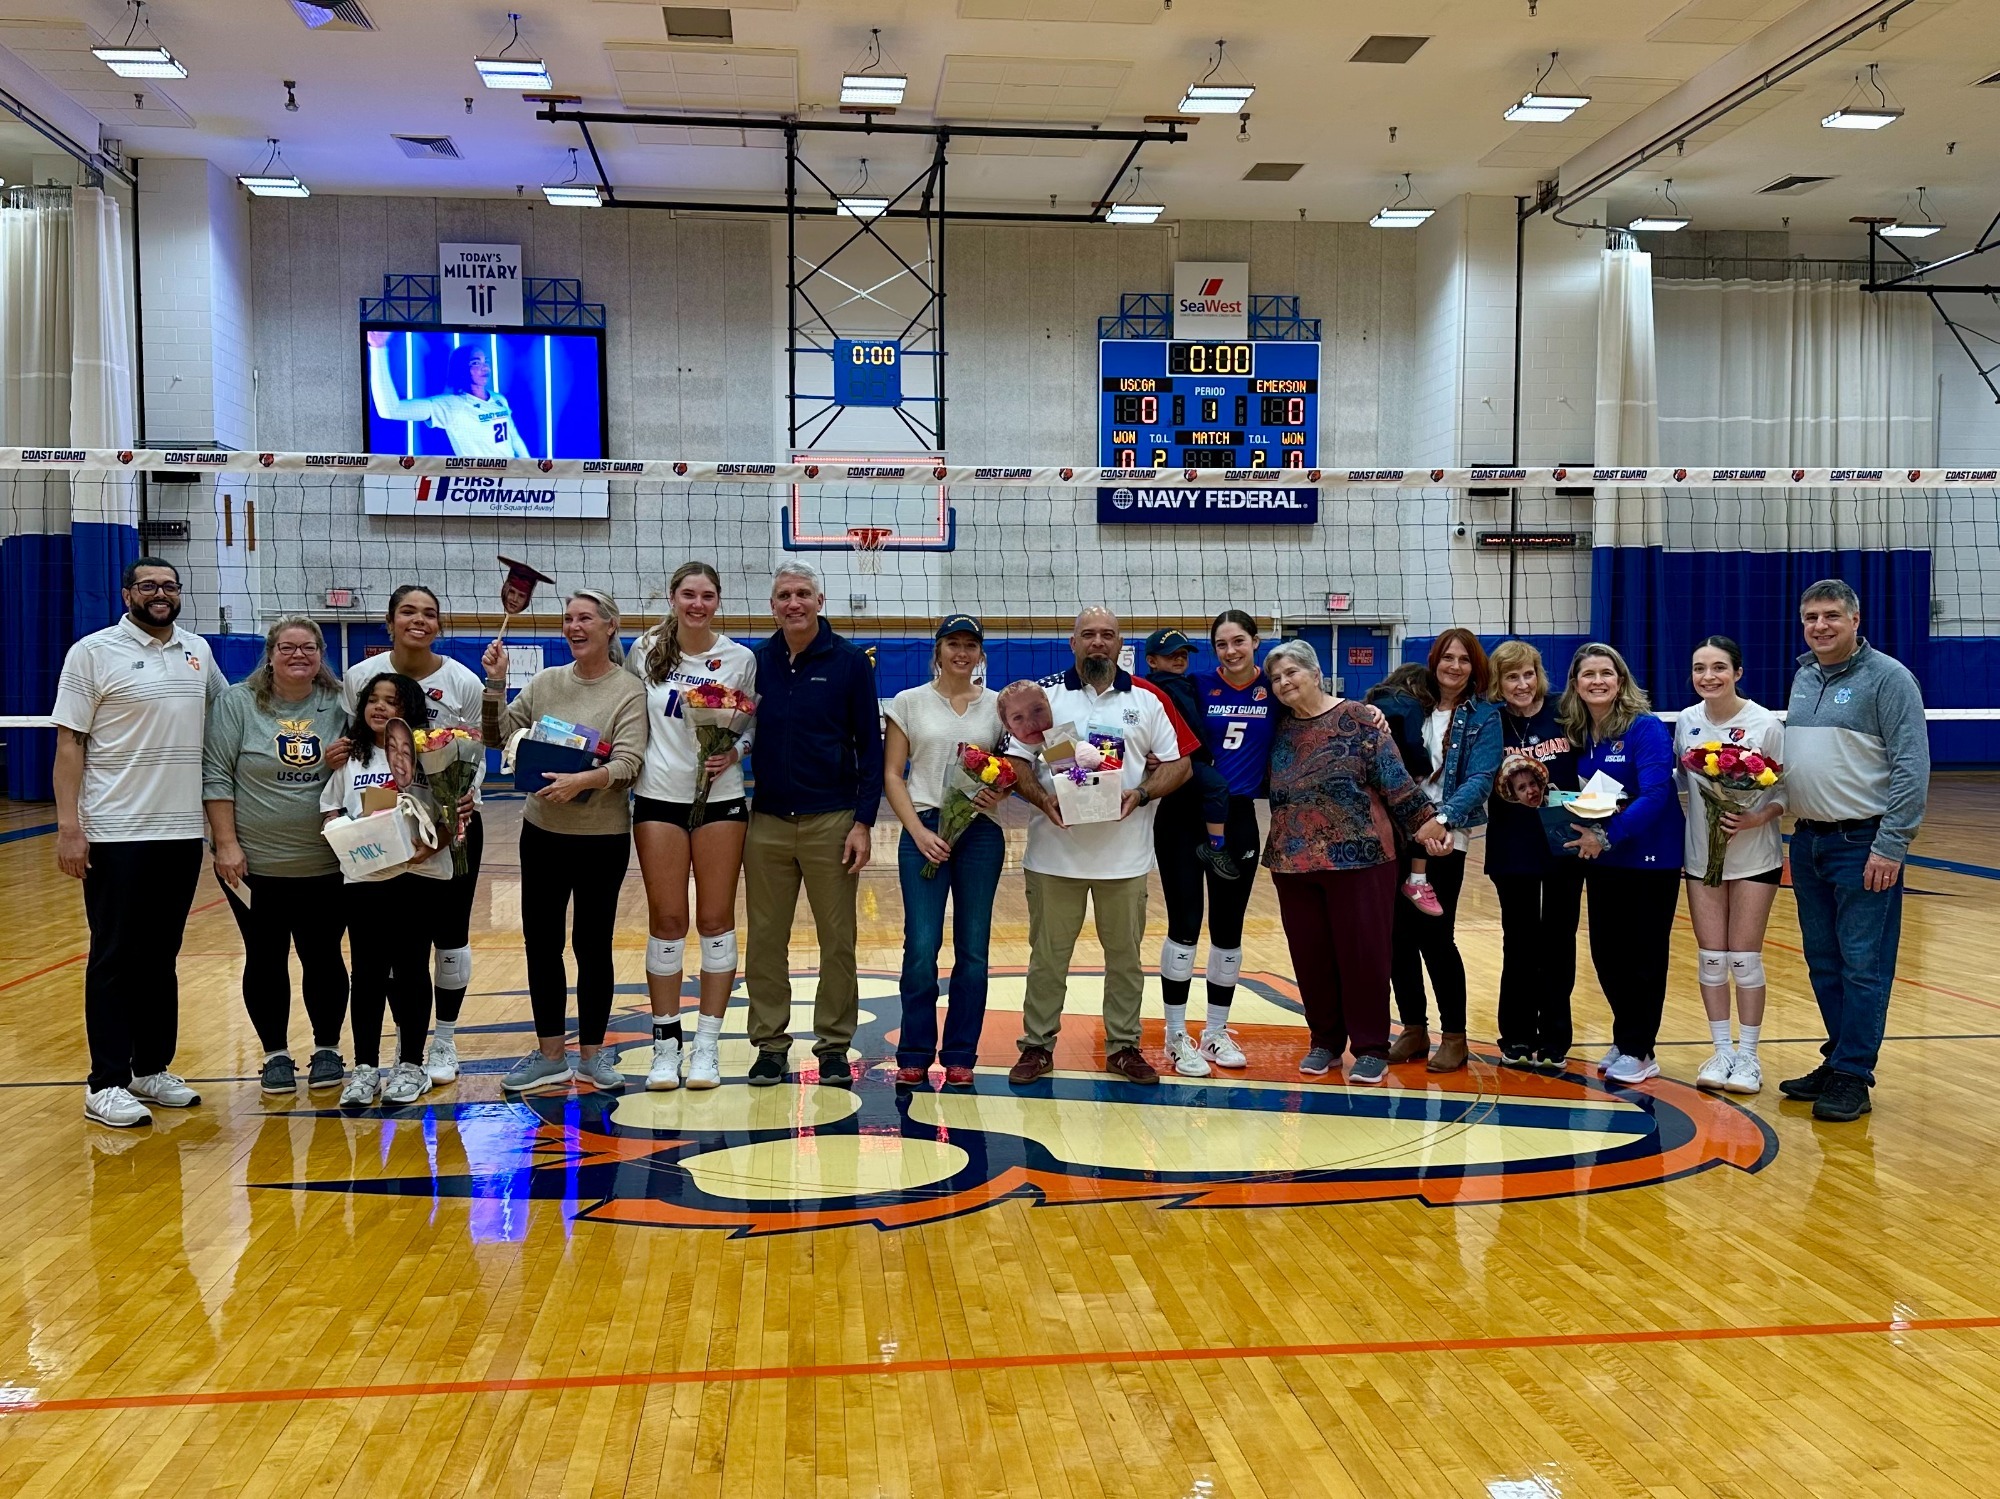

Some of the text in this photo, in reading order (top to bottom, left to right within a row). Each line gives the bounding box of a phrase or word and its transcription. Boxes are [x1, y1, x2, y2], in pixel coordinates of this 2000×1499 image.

[460, 252, 502, 263] TODAY'S
[444, 264, 517, 280] MILITARY
[1180, 299, 1242, 313] SeaWest
[852, 345, 896, 366] 0:00
[1190, 345, 1250, 373] 0:00
[1120, 378, 1155, 392] USCGA
[1256, 380, 1307, 393] EMERSON
[1194, 386, 1225, 396] PERIOD
[1141, 396, 1157, 424] 0
[1211, 401, 1217, 420] 1
[1288, 397, 1304, 425] 0
[493, 421, 508, 444] 21
[1113, 430, 1135, 443] WON
[1149, 433, 1171, 443] T.O.L.
[1192, 431, 1230, 445] MATCH
[1248, 434, 1270, 443] T.O.L.
[1282, 432, 1304, 445] WON
[22, 451, 86, 460] COAST GUARD
[165, 453, 227, 463] COAST GUARD
[306, 455, 368, 465] COAST GUARD
[446, 458, 507, 467] COAST GUARD
[584, 461, 643, 471] COAST GUARD
[717, 464, 775, 473] COAST GUARD
[847, 467, 904, 477] COAST GUARD
[975, 468, 1031, 478] COAST GUARD
[1101, 469, 1156, 478] COAST GUARD
[1471, 469, 1526, 479] COAST GUARD
[1593, 469, 1647, 479] COAST GUARD
[1225, 471, 1280, 480] COAST GUARD
[1348, 470, 1403, 480] COAST GUARD
[1713, 470, 1766, 479] COAST GUARD
[1831, 470, 1882, 479] COAST GUARD
[1945, 470, 1997, 479] COAST GUARD
[450, 488, 556, 504] COMMAND
[1138, 490, 1302, 508] NAVY FEDERAL
[533, 504, 554, 512] Away
[1207, 704, 1268, 715] COAST GUARD
[1222, 721, 1248, 750] 5
[277, 771, 321, 783] USCGA
[354, 773, 391, 787] COAST
[348, 842, 388, 864] MACK
